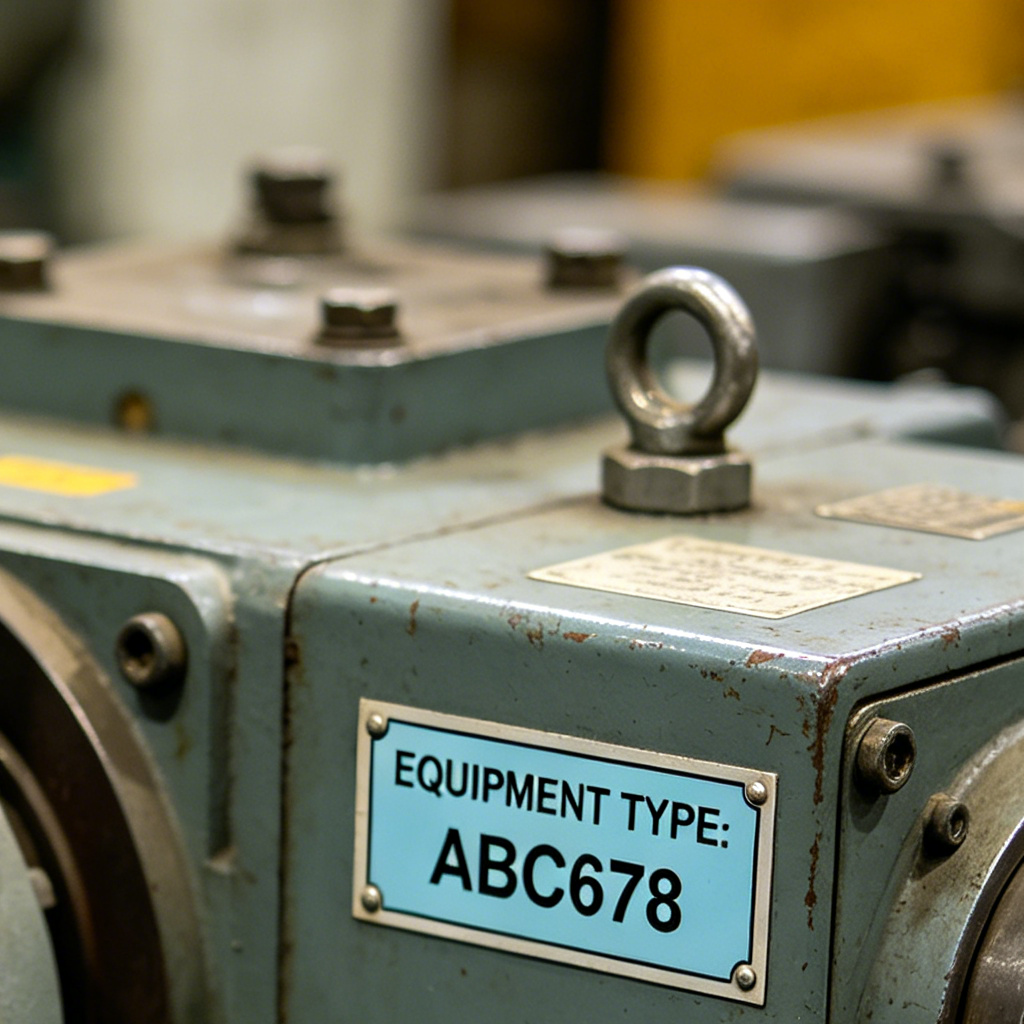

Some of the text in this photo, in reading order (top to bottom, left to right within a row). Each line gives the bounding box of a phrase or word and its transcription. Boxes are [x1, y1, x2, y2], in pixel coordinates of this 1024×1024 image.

[394, 750, 731, 849] EQUIPMENT TYPE:
[430, 827, 683, 933] ABC678
